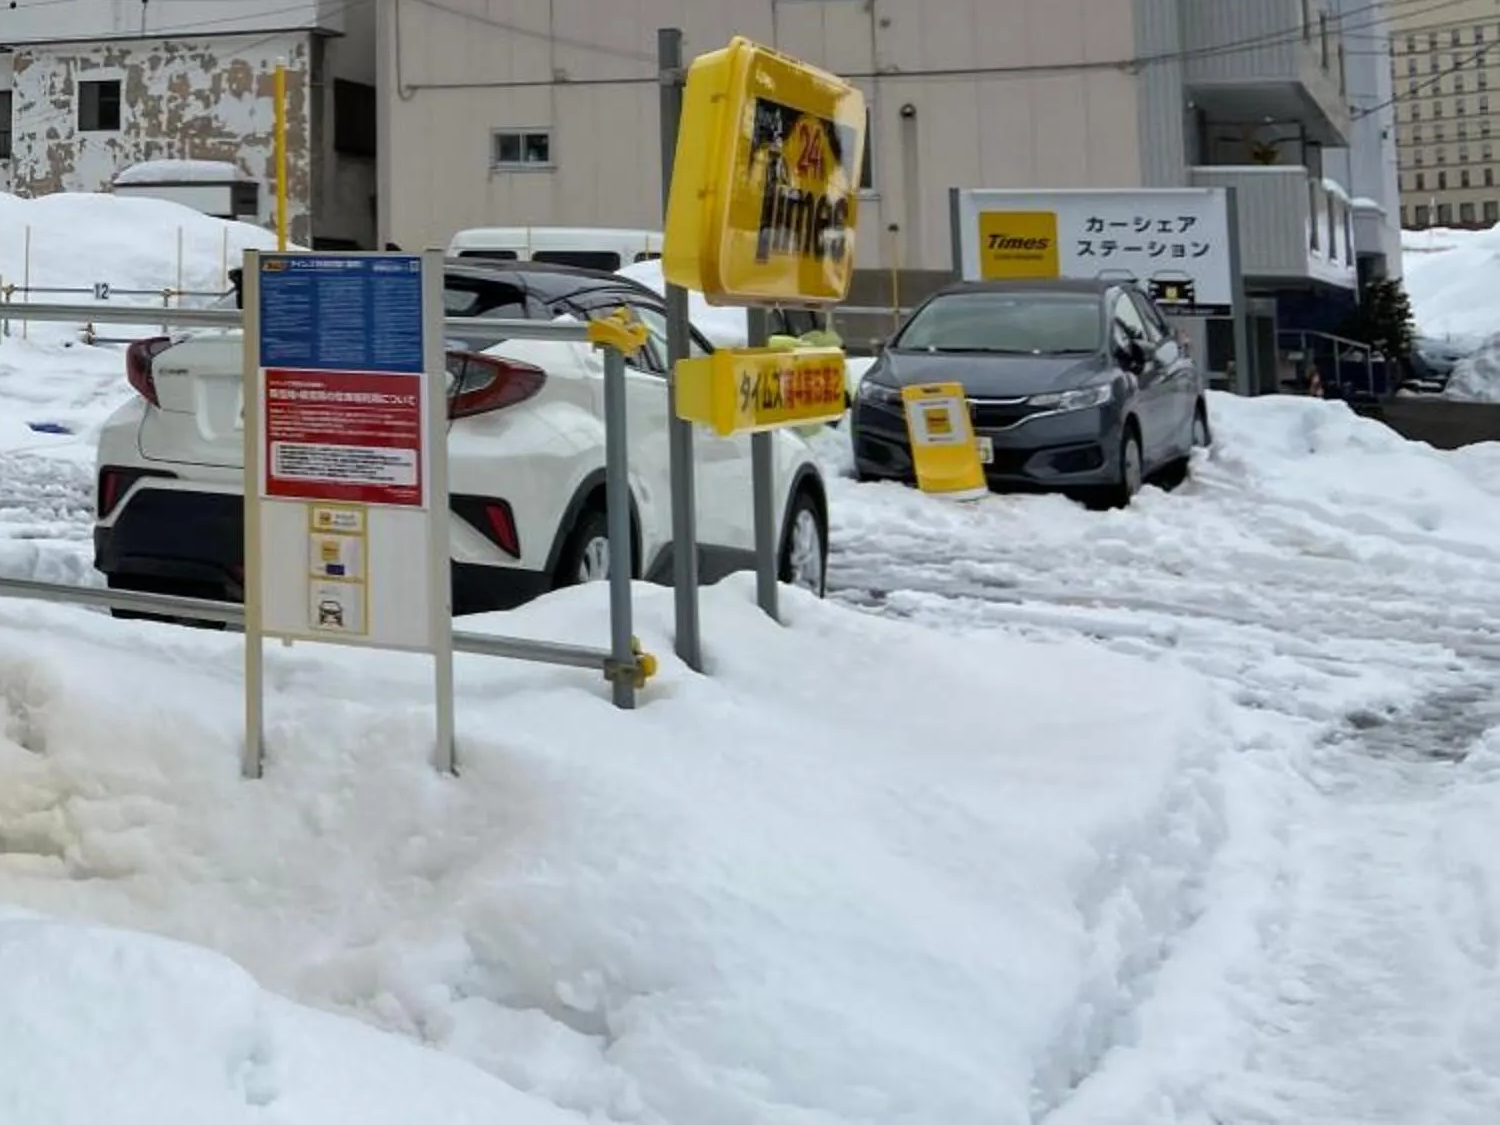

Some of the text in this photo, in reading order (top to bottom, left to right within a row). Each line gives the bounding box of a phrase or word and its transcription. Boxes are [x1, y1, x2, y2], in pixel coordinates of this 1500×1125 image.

[1085, 215, 1198, 234] カーシェア
[987, 233, 1052, 251] Times
[1076, 239, 1211, 258] ステーション
[94, 282, 110, 300] 12
